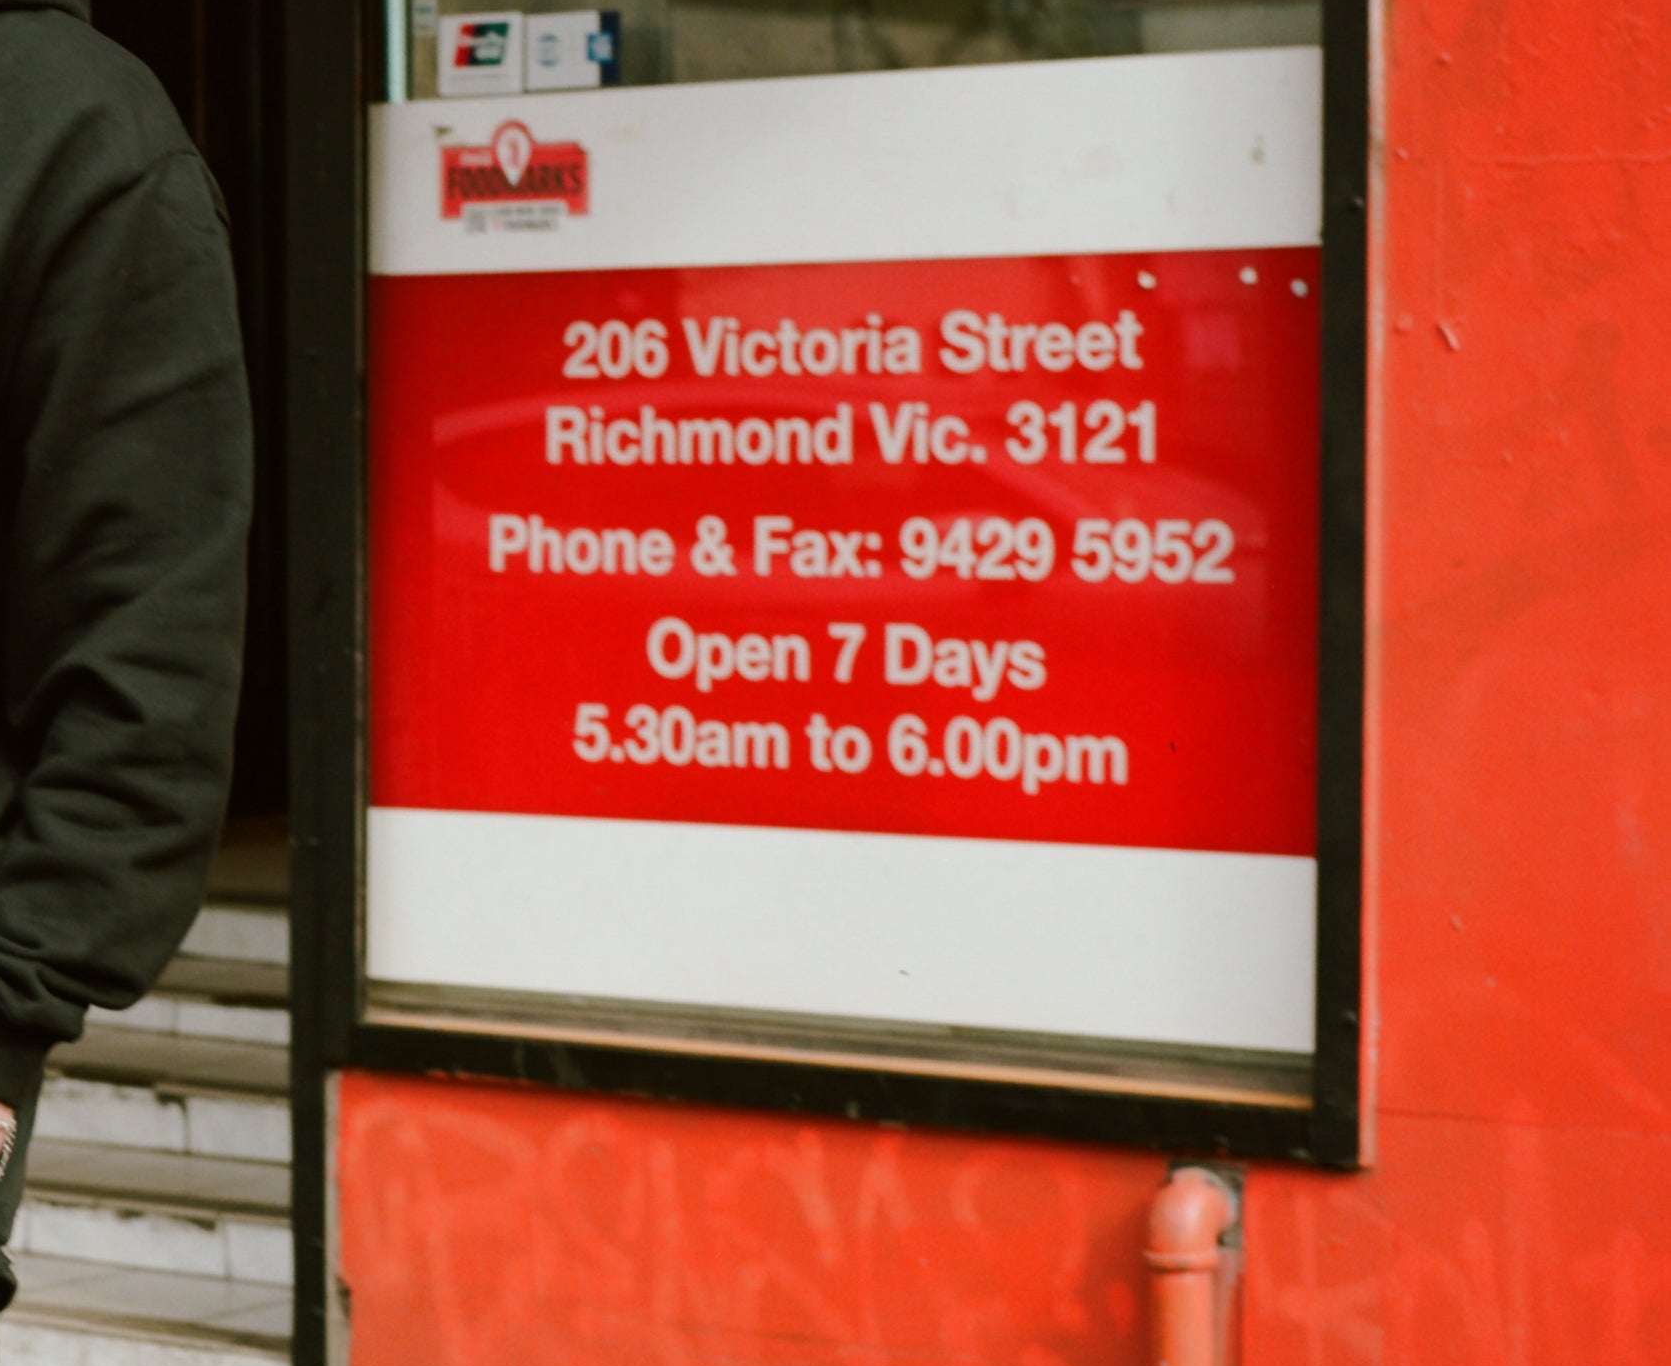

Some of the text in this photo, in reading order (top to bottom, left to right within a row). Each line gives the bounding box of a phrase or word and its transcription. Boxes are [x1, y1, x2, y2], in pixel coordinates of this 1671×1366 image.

[562, 308, 1145, 379] 206 Victoria Street
[544, 399, 1157, 466] Richmond Vic. 3121
[487, 513, 1236, 586] Phone & Fax: 9429 5952
[645, 616, 1048, 703] Open 7 Days
[572, 702, 1129, 796] 5.30am to 6.00pm
